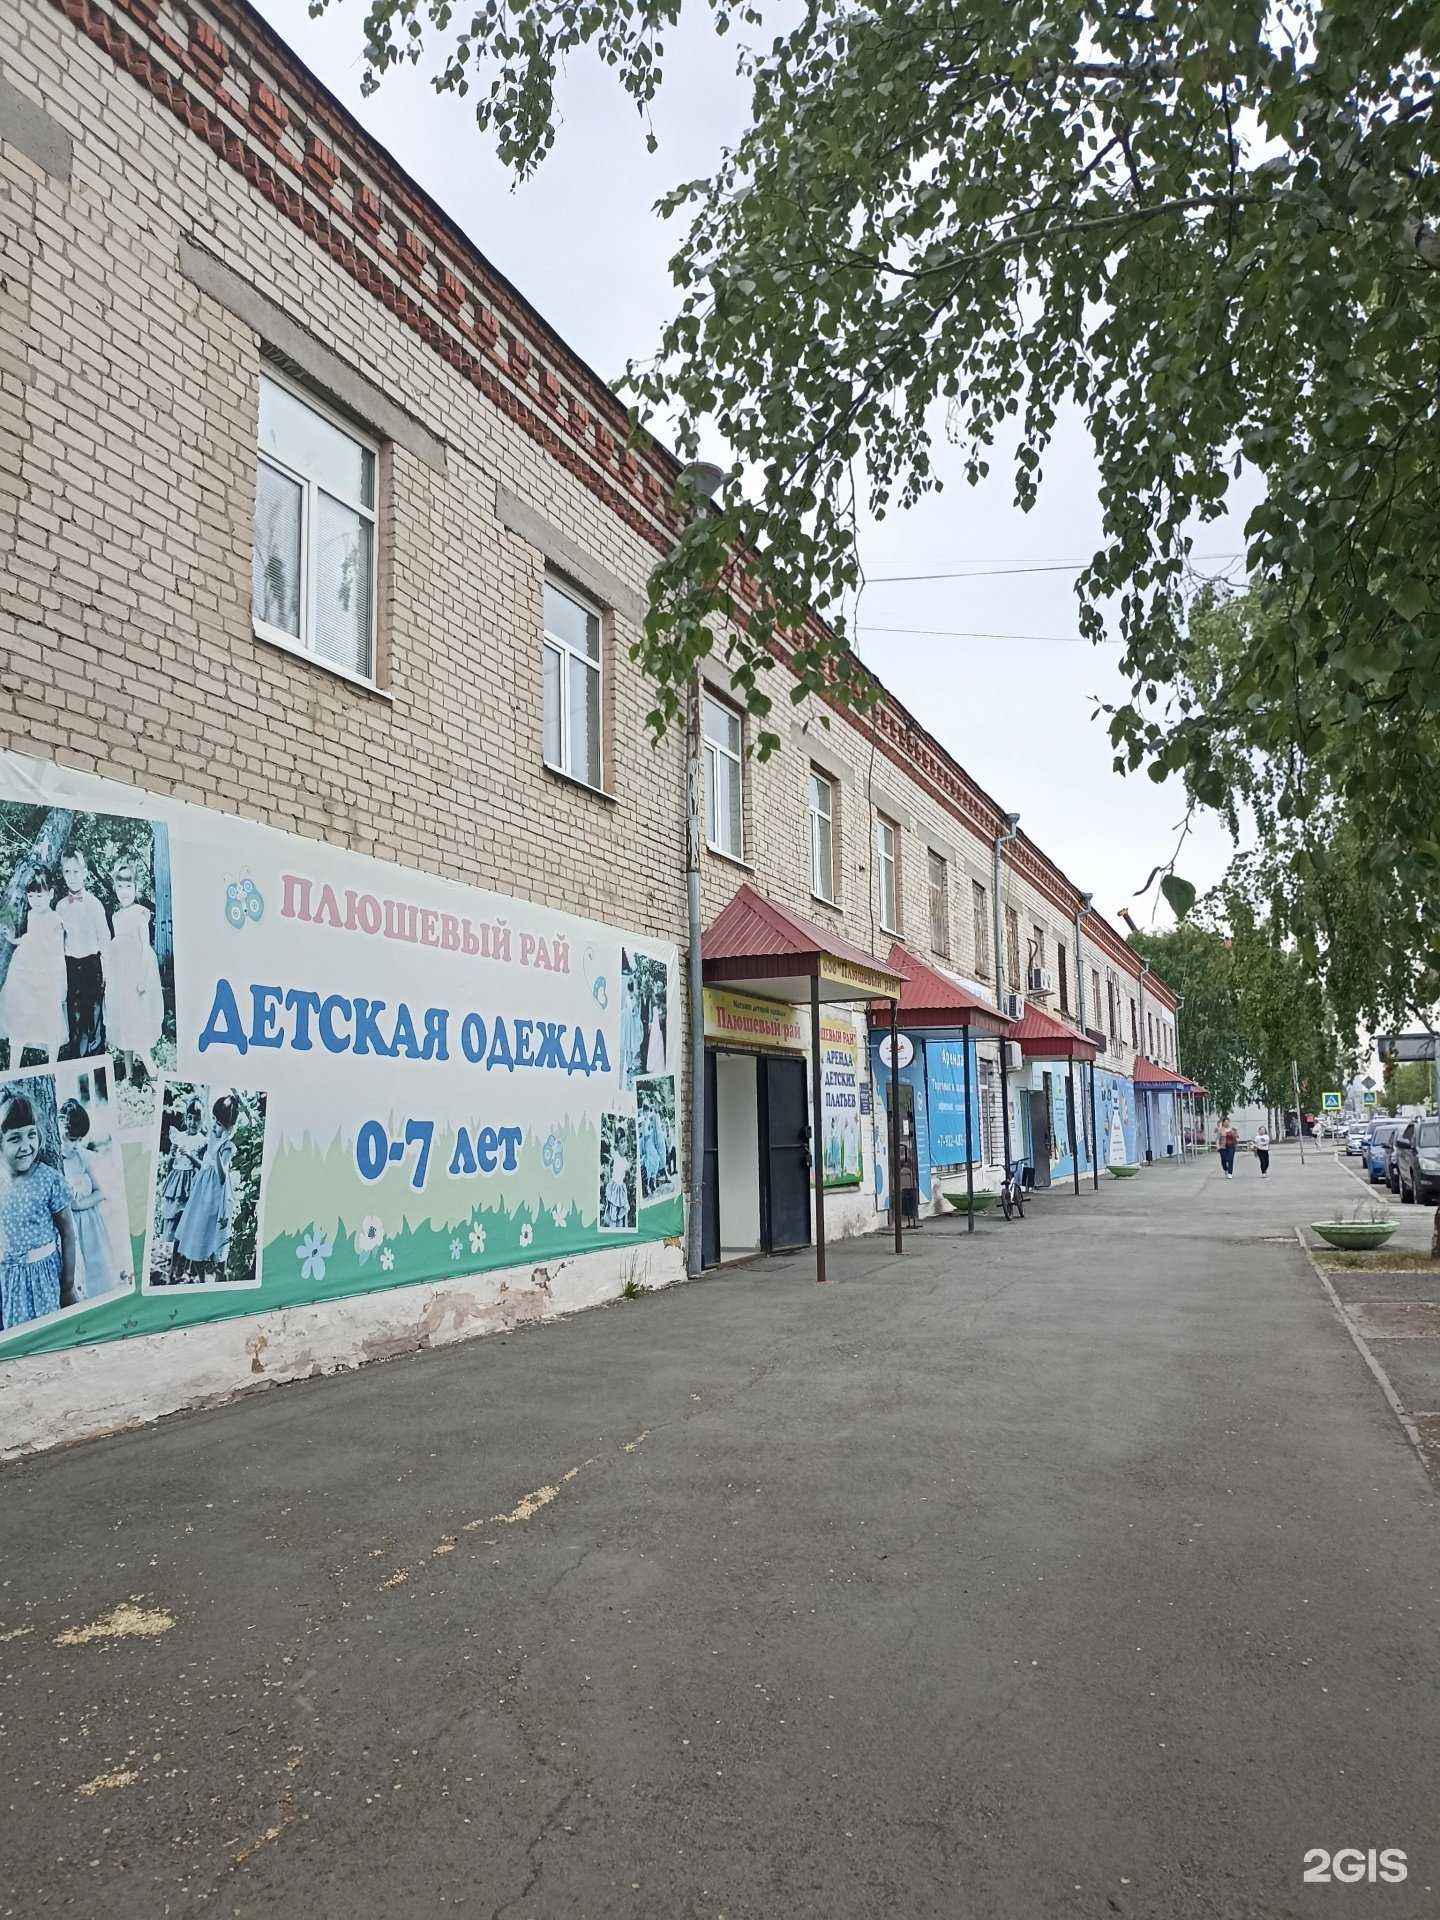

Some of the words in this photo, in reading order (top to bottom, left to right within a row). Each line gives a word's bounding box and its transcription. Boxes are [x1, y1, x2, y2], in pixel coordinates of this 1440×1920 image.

[280, 874, 512, 962] ПЛЮШЕВЫЙ
[519, 934, 571, 974] РАЙ
[198, 978, 450, 1061] ДЕТСКАЯ
[461, 1012, 611, 1077] ОДЕЖДА
[716, 1006, 781, 1037] Плюшевый
[783, 1022, 800, 1042] рай
[826, 1050, 853, 1067] АРЕНДА
[825, 1071, 856, 1088] ДЕТСКИХ
[825, 1092, 856, 1109] ПЛАТЬЕВ
[356, 1118, 435, 1188] 0-7
[448, 1126, 523, 1175] лет
